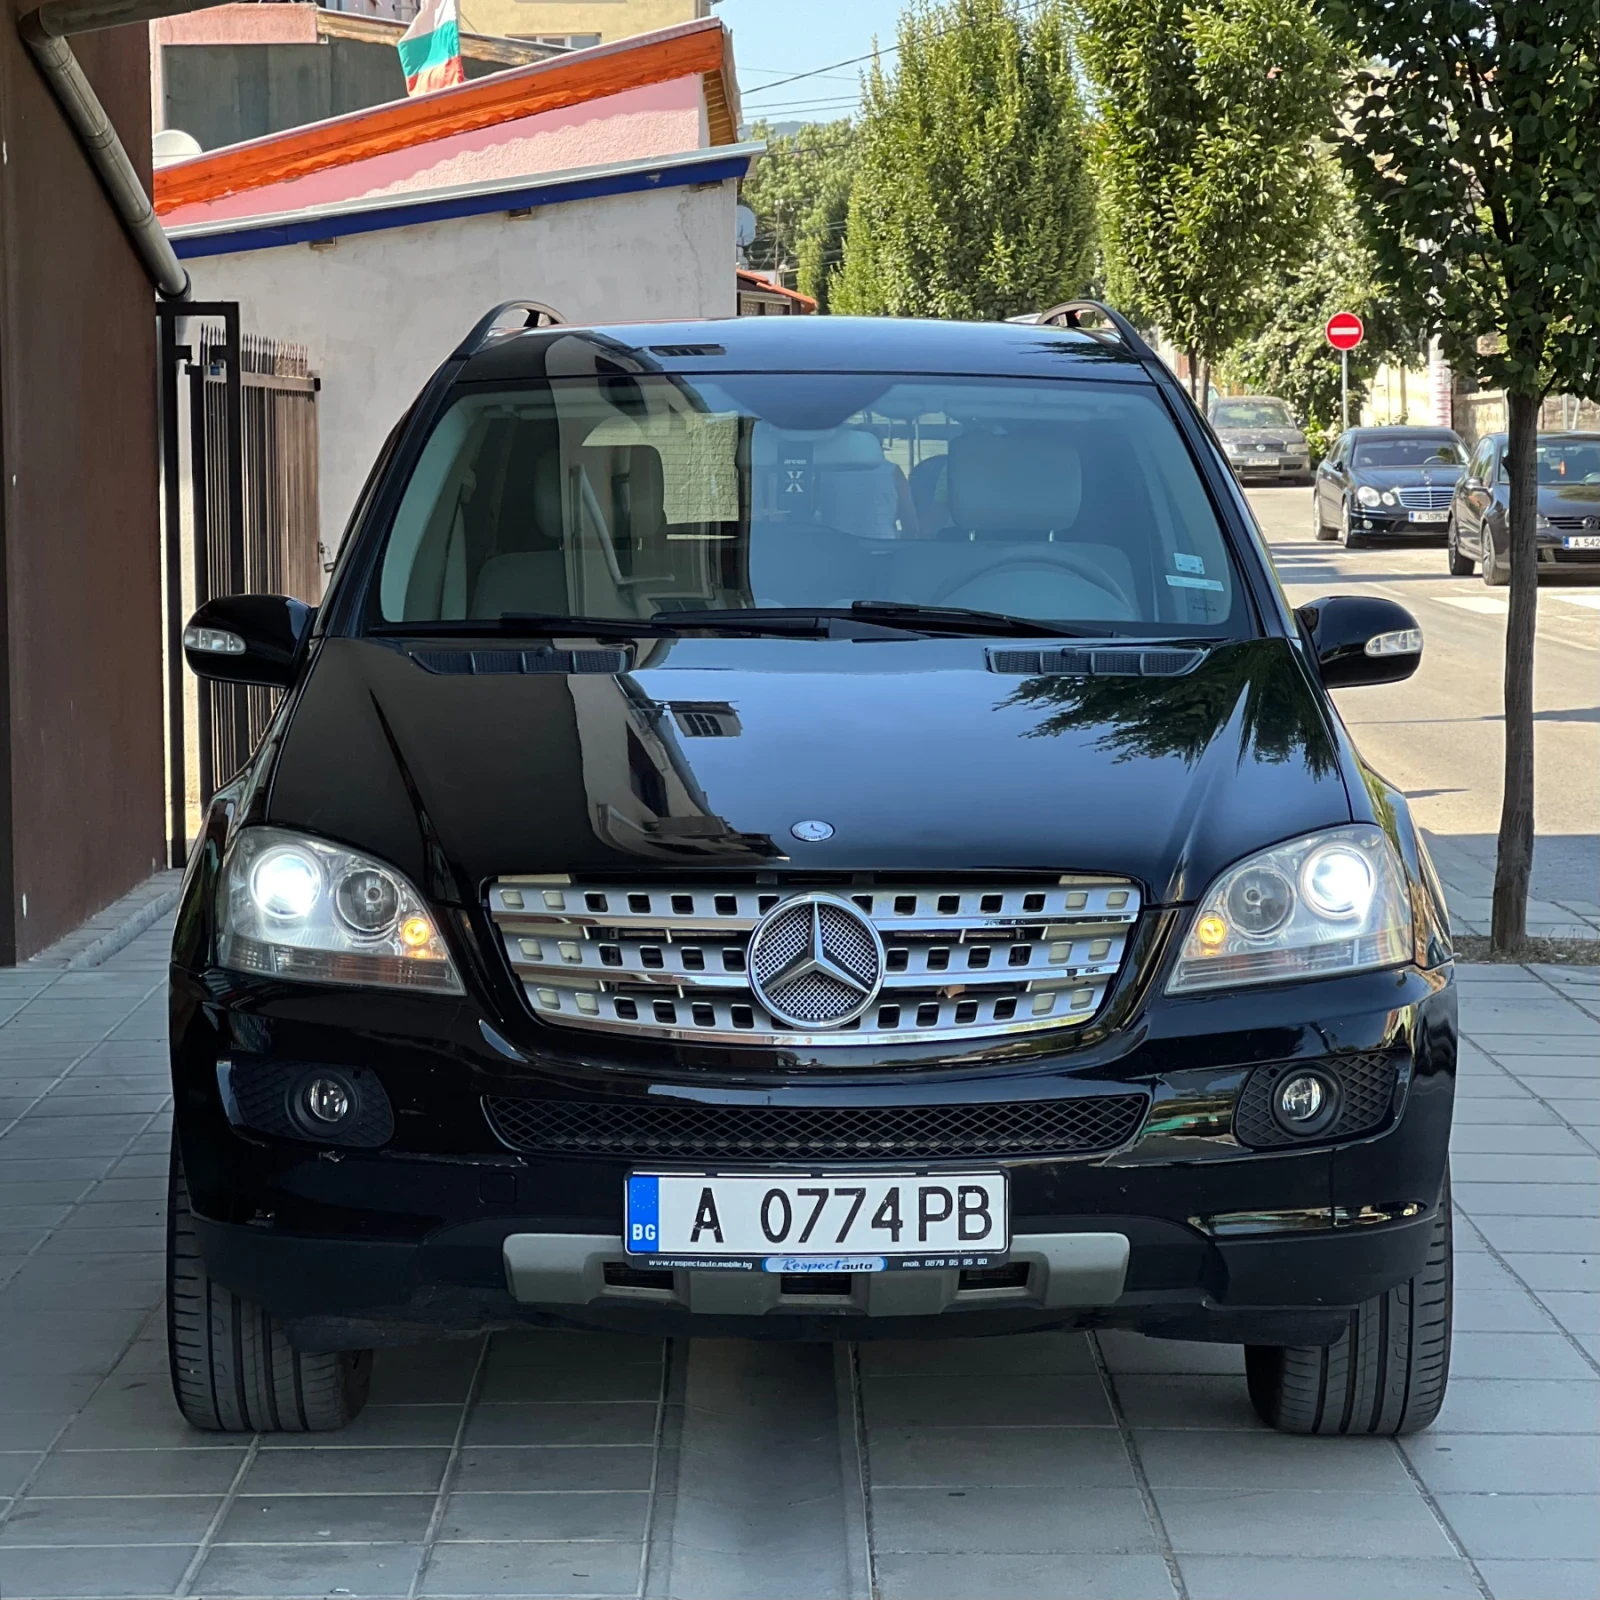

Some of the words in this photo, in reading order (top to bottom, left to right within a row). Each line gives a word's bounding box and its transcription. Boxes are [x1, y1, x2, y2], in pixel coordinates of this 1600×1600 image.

[1573, 538, 1580, 547] A
[689, 1187, 724, 1243] A
[632, 1224, 656, 1240] BG
[648, 1259, 752, 1269] www.respectauto.mobile.bg
